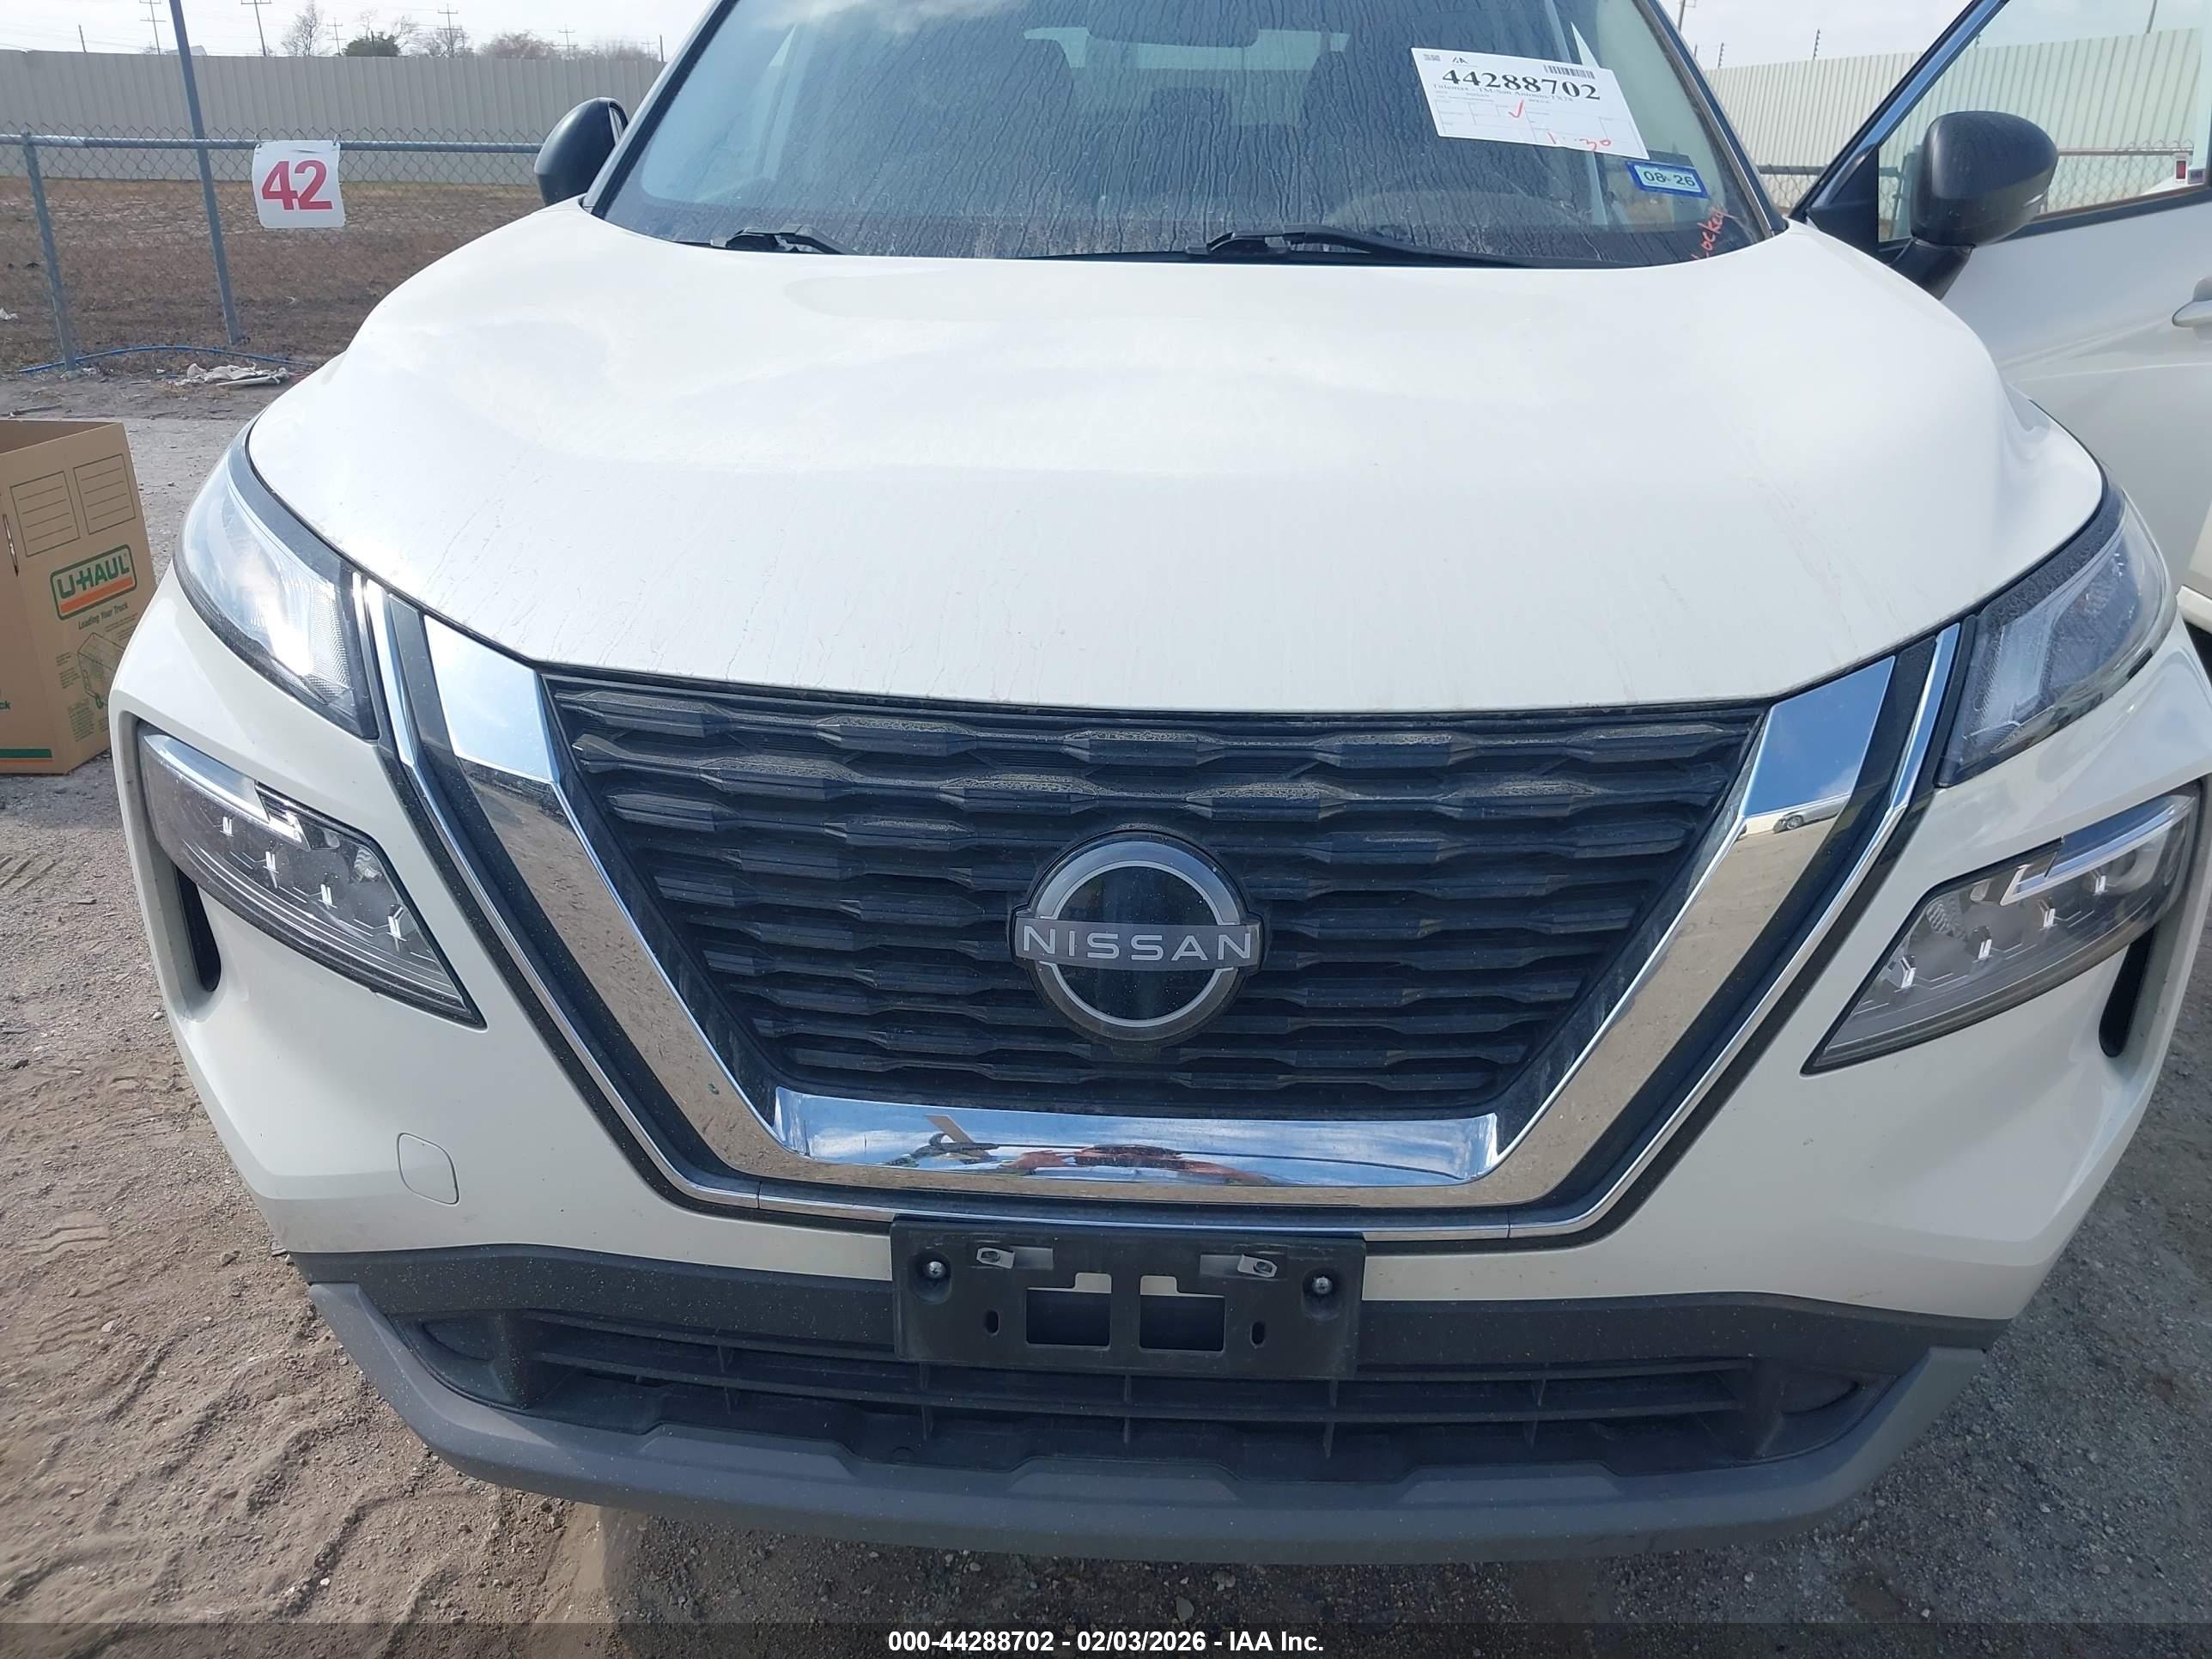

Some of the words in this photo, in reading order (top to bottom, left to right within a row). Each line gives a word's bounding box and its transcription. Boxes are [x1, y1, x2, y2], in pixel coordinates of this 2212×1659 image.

[1443, 70, 1601, 100] 44288702
[262, 160, 332, 210] 42
[1644, 171, 1666, 183] 08
[1674, 174, 1696, 187] 26
[57, 555, 131, 599] U-HAUL
[78, 615, 100, 630] Loading
[100, 610, 113, 620] Your
[114, 602, 128, 614] Truck
[1023, 925, 1251, 961] NISSAN
